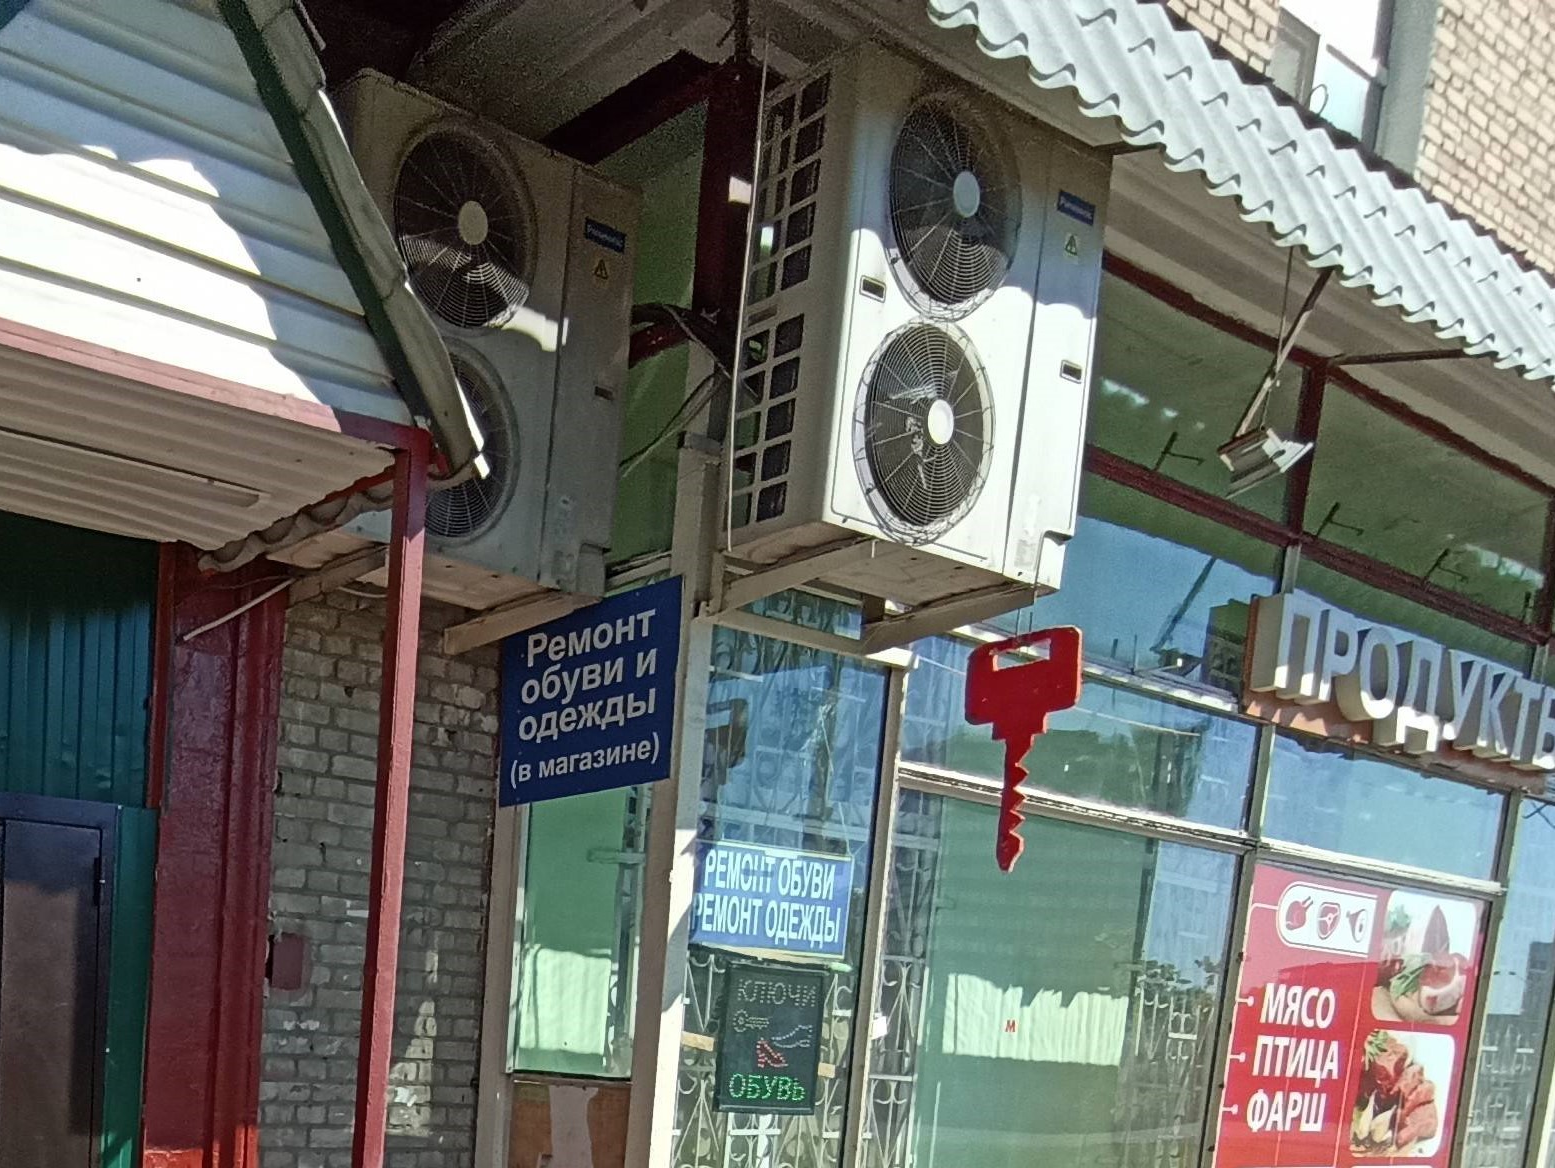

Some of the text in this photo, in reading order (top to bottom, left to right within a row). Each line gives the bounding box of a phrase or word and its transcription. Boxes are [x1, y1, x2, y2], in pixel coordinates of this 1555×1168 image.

[527, 608, 656, 668] Ремонт
[521, 647, 657, 705] обуви и
[518, 687, 657, 743] одежды
[510, 731, 660, 789] (в магазине)
[703, 848, 837, 901] РЕМОНТ ОБУВИ
[694, 891, 842, 949] РЕМОНТ ОДЕЖДЫ
[738, 978, 817, 1007] КЛЮЧИ
[1259, 982, 1336, 1029] МЯСО
[729, 1072, 806, 1101] ОБУВЬ
[1252, 1034, 1339, 1089] ПТИЦА
[1246, 1088, 1327, 1133] ФАРШ
